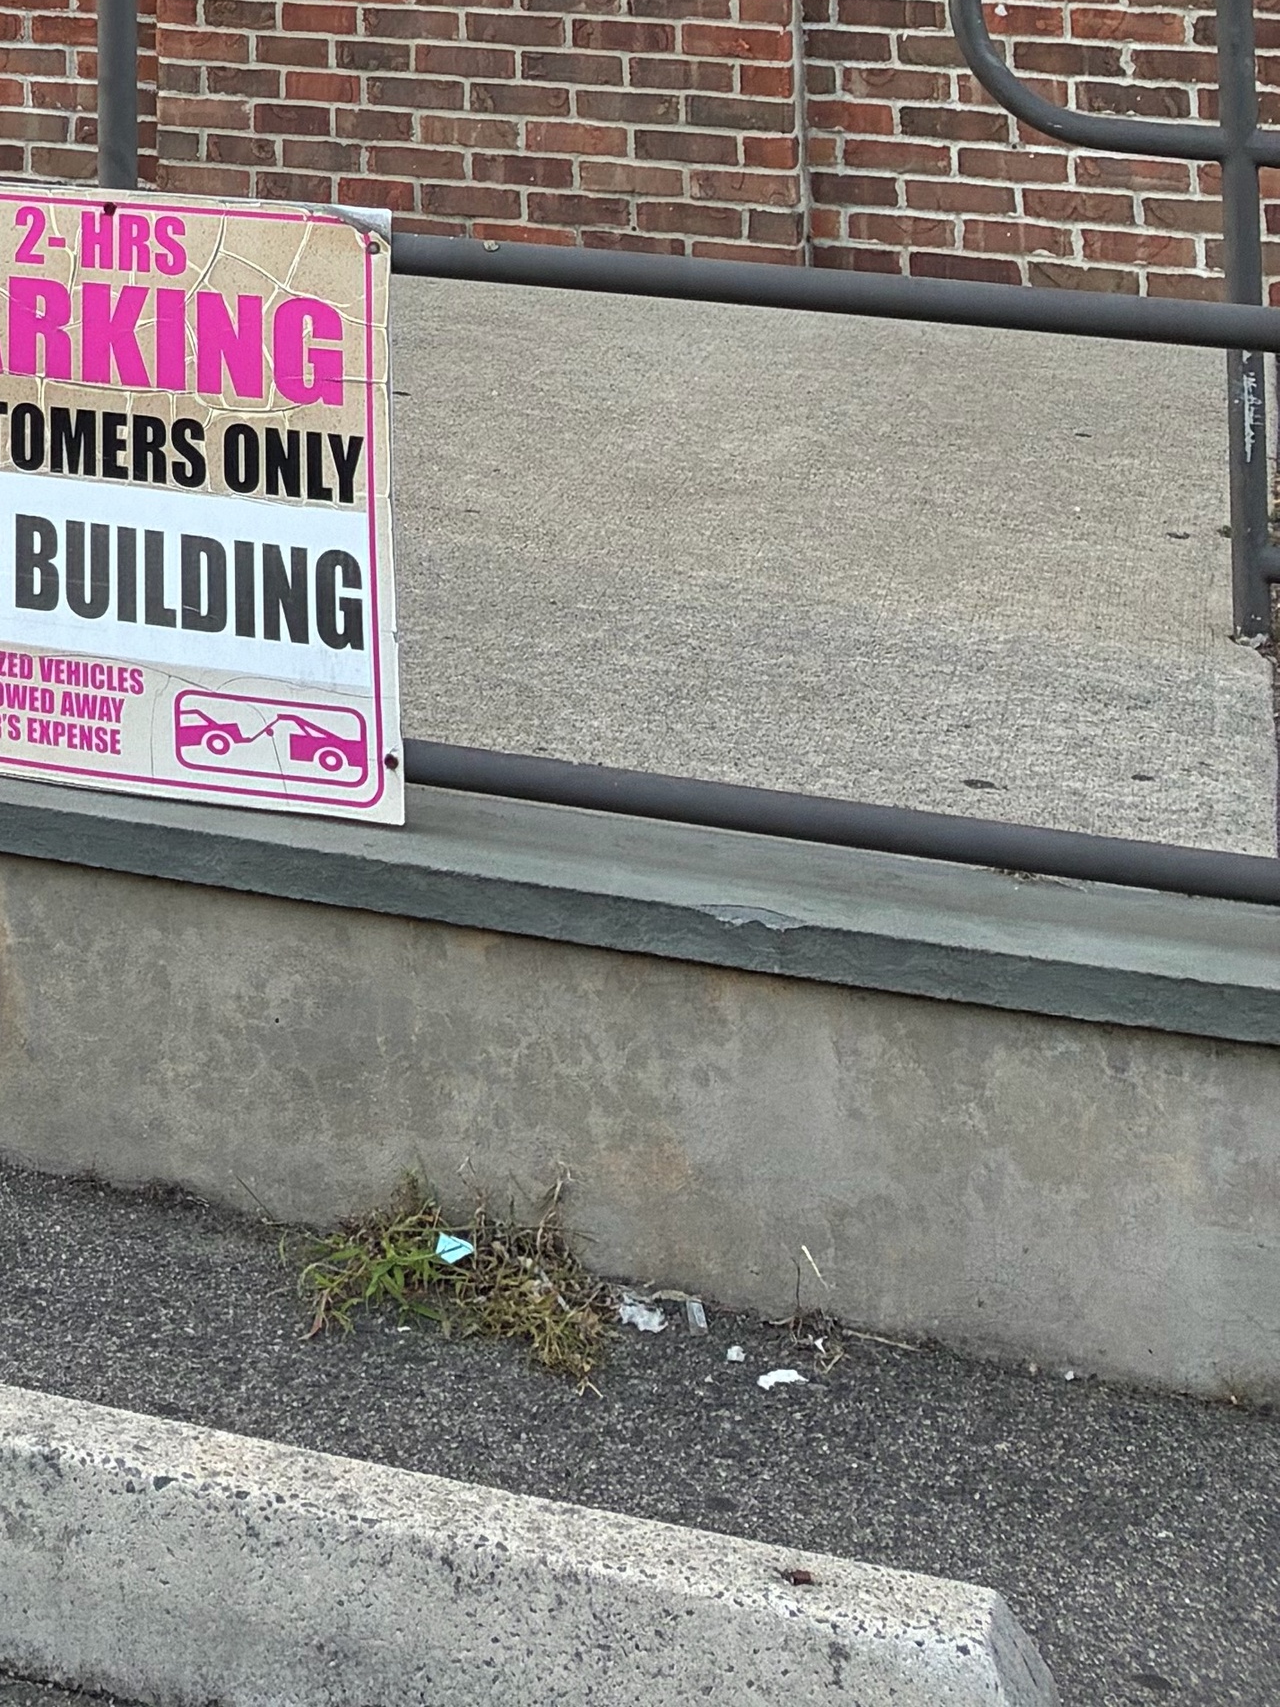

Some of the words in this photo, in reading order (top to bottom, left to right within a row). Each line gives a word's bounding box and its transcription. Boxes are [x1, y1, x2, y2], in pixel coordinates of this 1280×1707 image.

[80, 207, 187, 276] HRS
[223, 422, 365, 504] ONLY
[15, 513, 366, 652] BUILDING
[39, 655, 145, 696] VEHICLES
[60, 690, 125, 724] AWAY
[27, 716, 123, 756] EXPENSE
